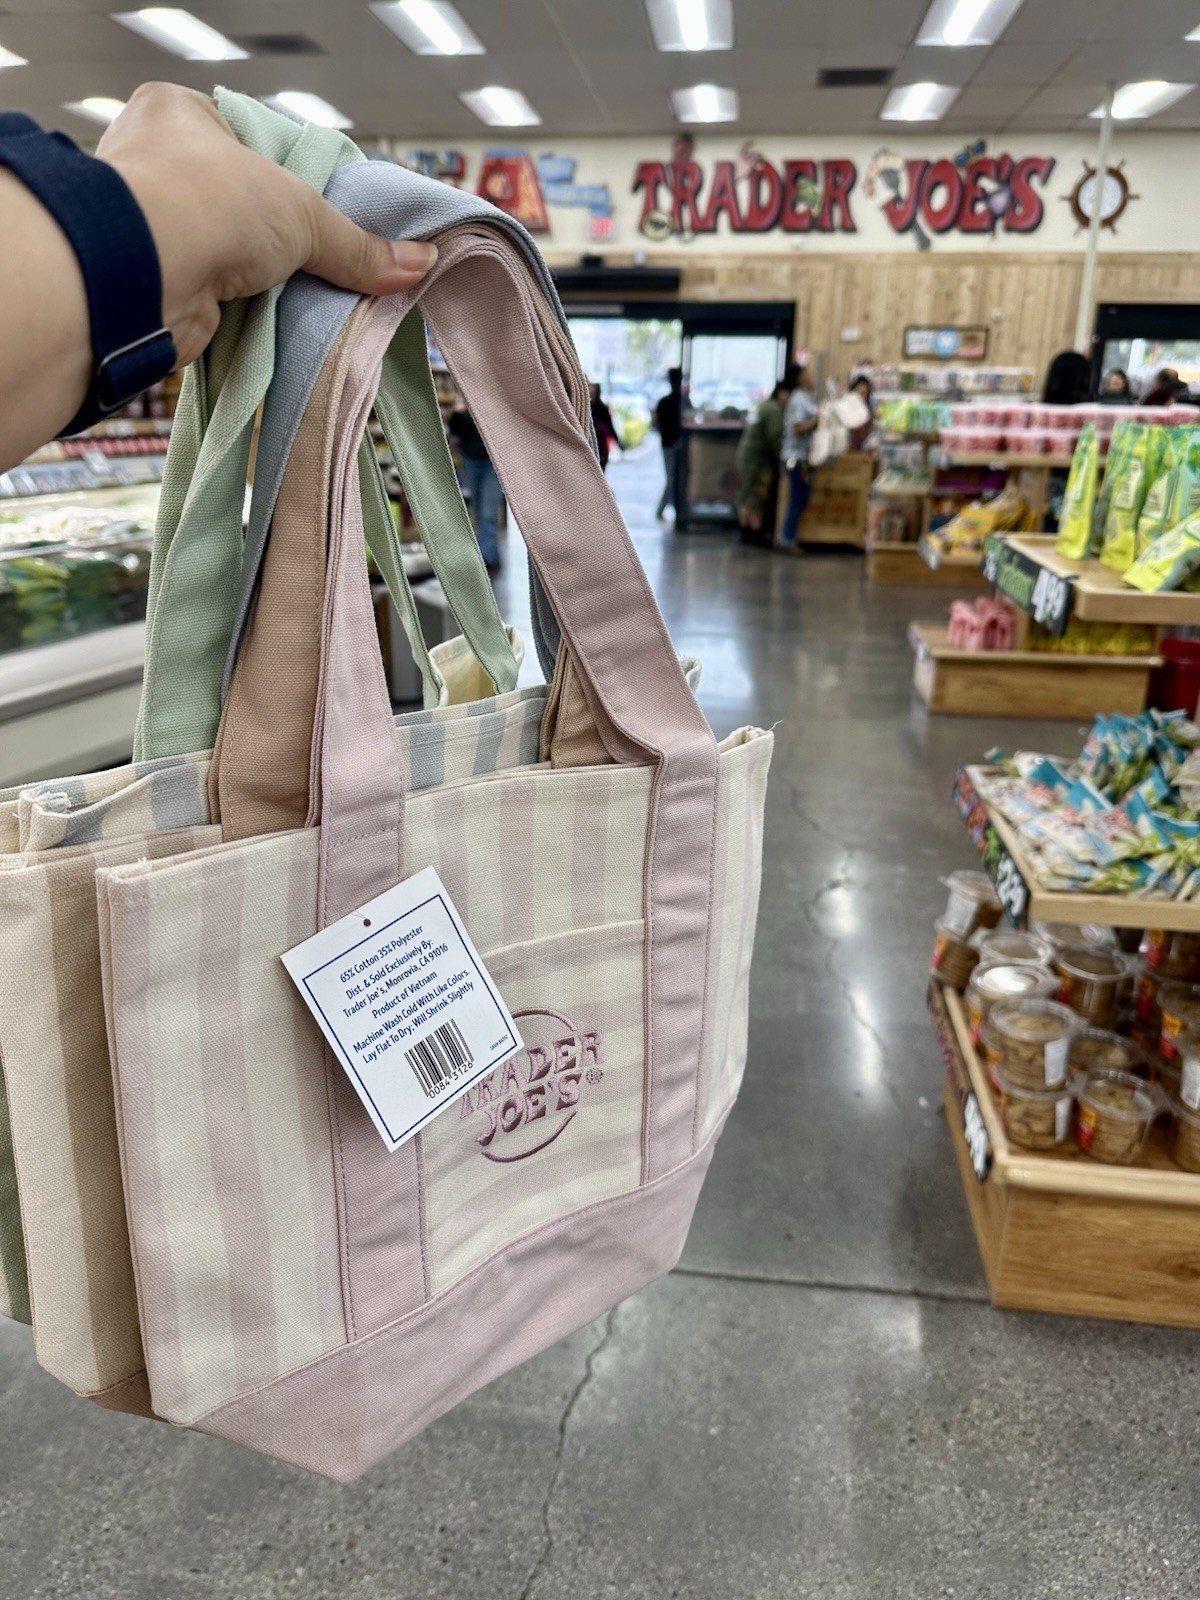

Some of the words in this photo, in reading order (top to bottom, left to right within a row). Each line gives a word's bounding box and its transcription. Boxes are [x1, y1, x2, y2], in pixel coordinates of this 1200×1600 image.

[632, 159, 857, 233] TRADER
[882, 155, 1056, 234] JOE'S
[339, 967, 356, 983] 65%
[353, 954, 380, 974] Cotton
[377, 943, 393, 959] 35%
[390, 925, 423, 950] Polyester
[342, 998, 371, 1018] Trader
[366, 986, 388, 1005] Joe's,
[385, 964, 422, 990] Monrovia,
[418, 955, 431, 967] CA
[427, 943, 449, 961] 91016
[345, 984, 365, 1000] Dist.
[363, 979, 372, 989] &
[369, 967, 387, 984] Sold
[384, 946, 423, 974] Exclusively
[420, 939, 435, 951] By:
[352, 1028, 385, 1054] Machine
[381, 1014, 404, 1032] Wash
[401, 1002, 419, 1019] Cold
[415, 992, 436, 1008] With
[432, 983, 449, 997] Like
[446, 969, 470, 987] Colors.
[362, 1050, 378, 1064] Lay
[375, 1039, 392, 1055] Flat
[388, 1034, 400, 1044] To
[397, 1024, 415, 1039] Dry;
[411, 1012, 428, 1028] Will
[425, 998, 450, 1019] Shrink
[447, 981, 474, 1003] Slightly
[371, 995, 402, 1019] Product
[400, 987, 409, 1000] of
[407, 971, 438, 994] Vietnam
[428, 1080, 451, 1099] 0084
[453, 1061, 474, 1081] 3126
[476, 1069, 583, 1147] JOE'S
